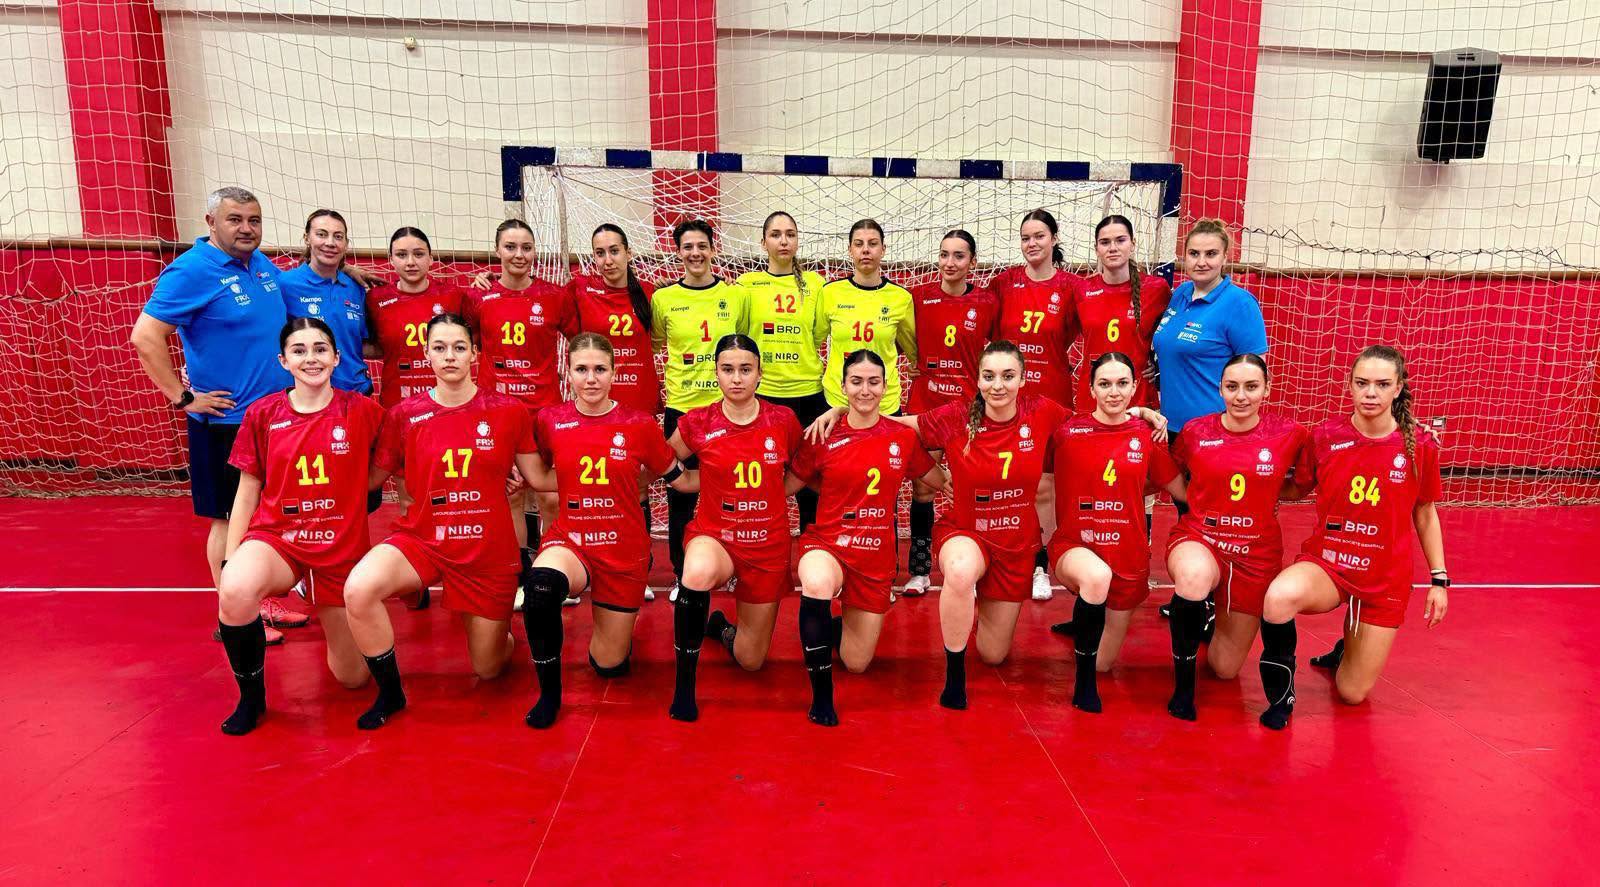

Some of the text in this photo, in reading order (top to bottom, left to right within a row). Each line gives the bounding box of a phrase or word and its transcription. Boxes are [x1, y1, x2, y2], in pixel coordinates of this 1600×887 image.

[220, 275, 239, 285] Kempa
[1085, 288, 1104, 297] Kempa
[378, 298, 398, 308] Kempa
[774, 294, 796, 313] 12
[609, 314, 634, 336] 22
[1020, 311, 1045, 333] 37
[501, 322, 525, 346] 18
[700, 320, 712, 342] 1
[777, 325, 801, 334] BRD
[852, 321, 874, 343] 16
[1107, 318, 1120, 342] 6
[944, 325, 956, 347] 8
[1019, 344, 1043, 354] BRD
[775, 352, 799, 360] NIRO
[506, 360, 531, 368] BRD
[940, 360, 962, 368] BRD
[508, 383, 536, 392] NIRO
[694, 380, 718, 388] NIRO
[938, 383, 962, 392] NIRO
[410, 412, 434, 424] Kempa
[555, 421, 579, 430] Kempa
[705, 428, 726, 440] Kempa
[828, 438, 850, 450] Kempa
[1200, 439, 1224, 447] Kempa
[1331, 441, 1355, 451] Kempa
[442, 448, 473, 478] 17
[998, 452, 1013, 480] 7
[296, 454, 330, 486] 11
[580, 456, 609, 484] 21
[733, 461, 762, 488] 10
[1103, 459, 1116, 486] 4
[866, 468, 880, 495] 2
[1230, 474, 1246, 501] 9
[1349, 475, 1380, 506] 84
[449, 491, 481, 502] BRD
[993, 489, 1024, 500] BRD
[302, 498, 336, 512] BRD
[583, 498, 614, 508] BRD
[738, 500, 768, 510] BRD
[1095, 502, 1124, 511] BRD
[859, 508, 886, 518] BRD
[990, 516, 1020, 527] NIRO
[1220, 516, 1253, 527] BRD
[448, 525, 483, 534] NIRO
[1345, 520, 1378, 536] BRD
[298, 530, 335, 540] NIRO
[584, 531, 618, 541] NIRO
[737, 530, 767, 539] NIRO
[1094, 532, 1120, 541] NIRO
[852, 536, 881, 546] NIRO
[1218, 541, 1250, 554] NIRO
[1338, 553, 1370, 566] NIRO
